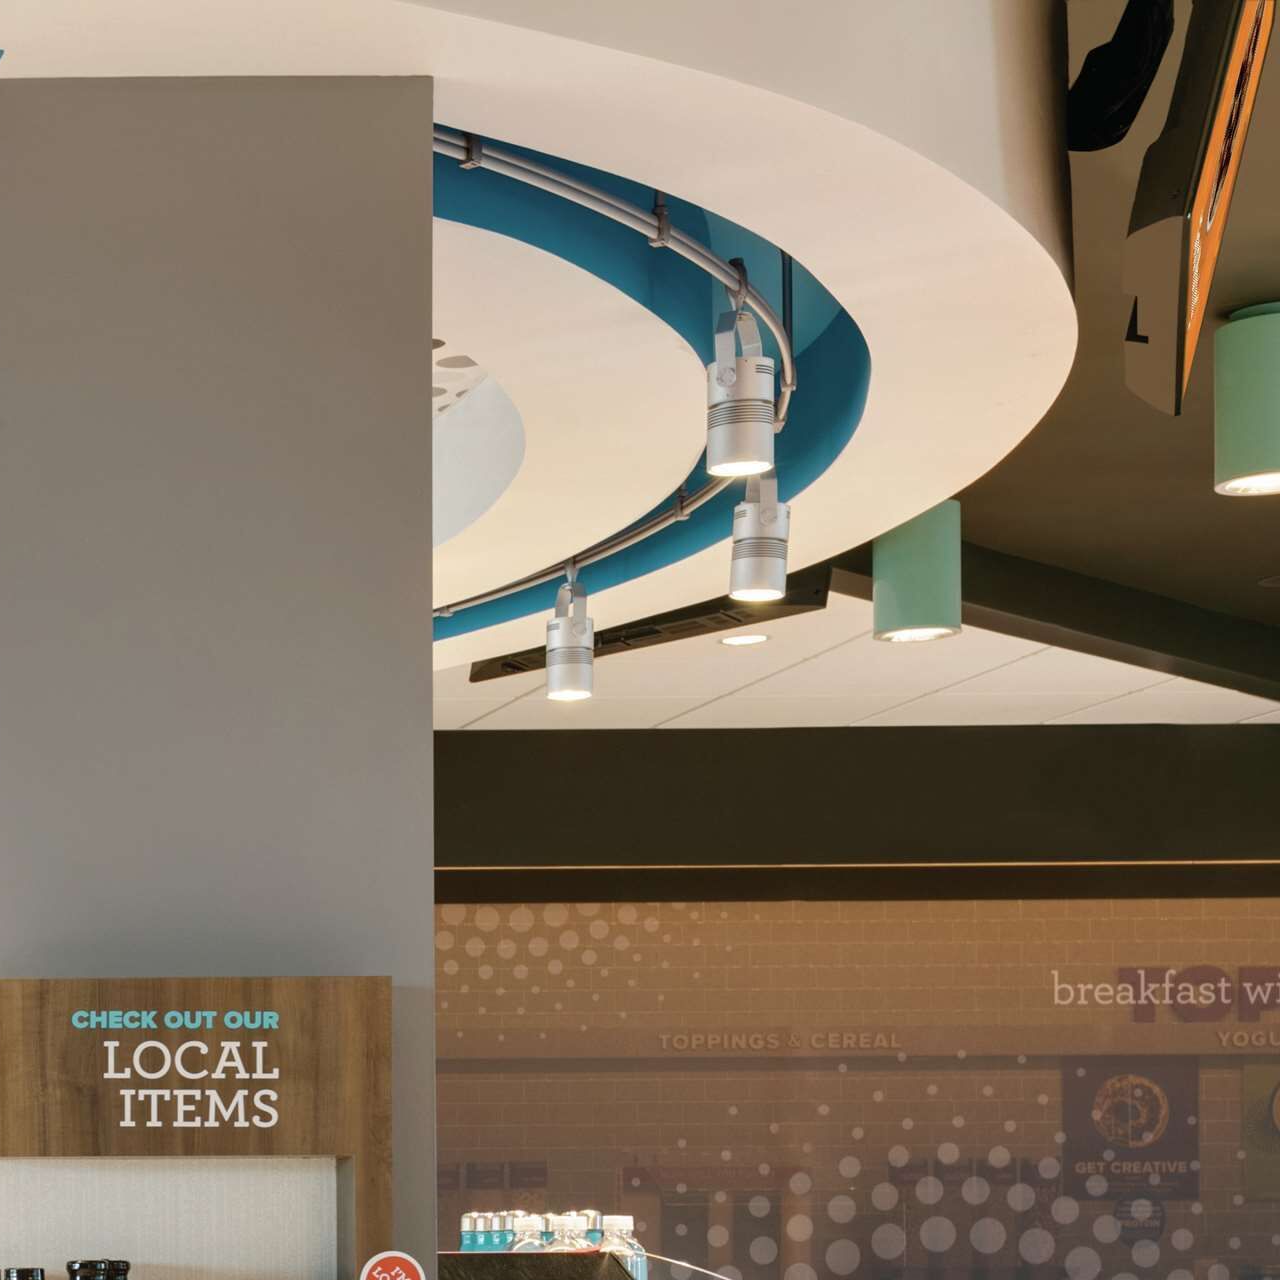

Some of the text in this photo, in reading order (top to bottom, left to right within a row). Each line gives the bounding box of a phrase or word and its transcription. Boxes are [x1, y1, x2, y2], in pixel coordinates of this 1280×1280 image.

[1051, 969, 1232, 1005] breakfast
[71, 1010, 280, 1030] CHECK OUT OUR
[659, 1032, 902, 1050] TOPPINGS & CEREAL
[103, 1040, 280, 1080] LOCAL
[119, 1088, 280, 1128] ITEMS
[1075, 1161, 1187, 1174] GET CREATIVE
